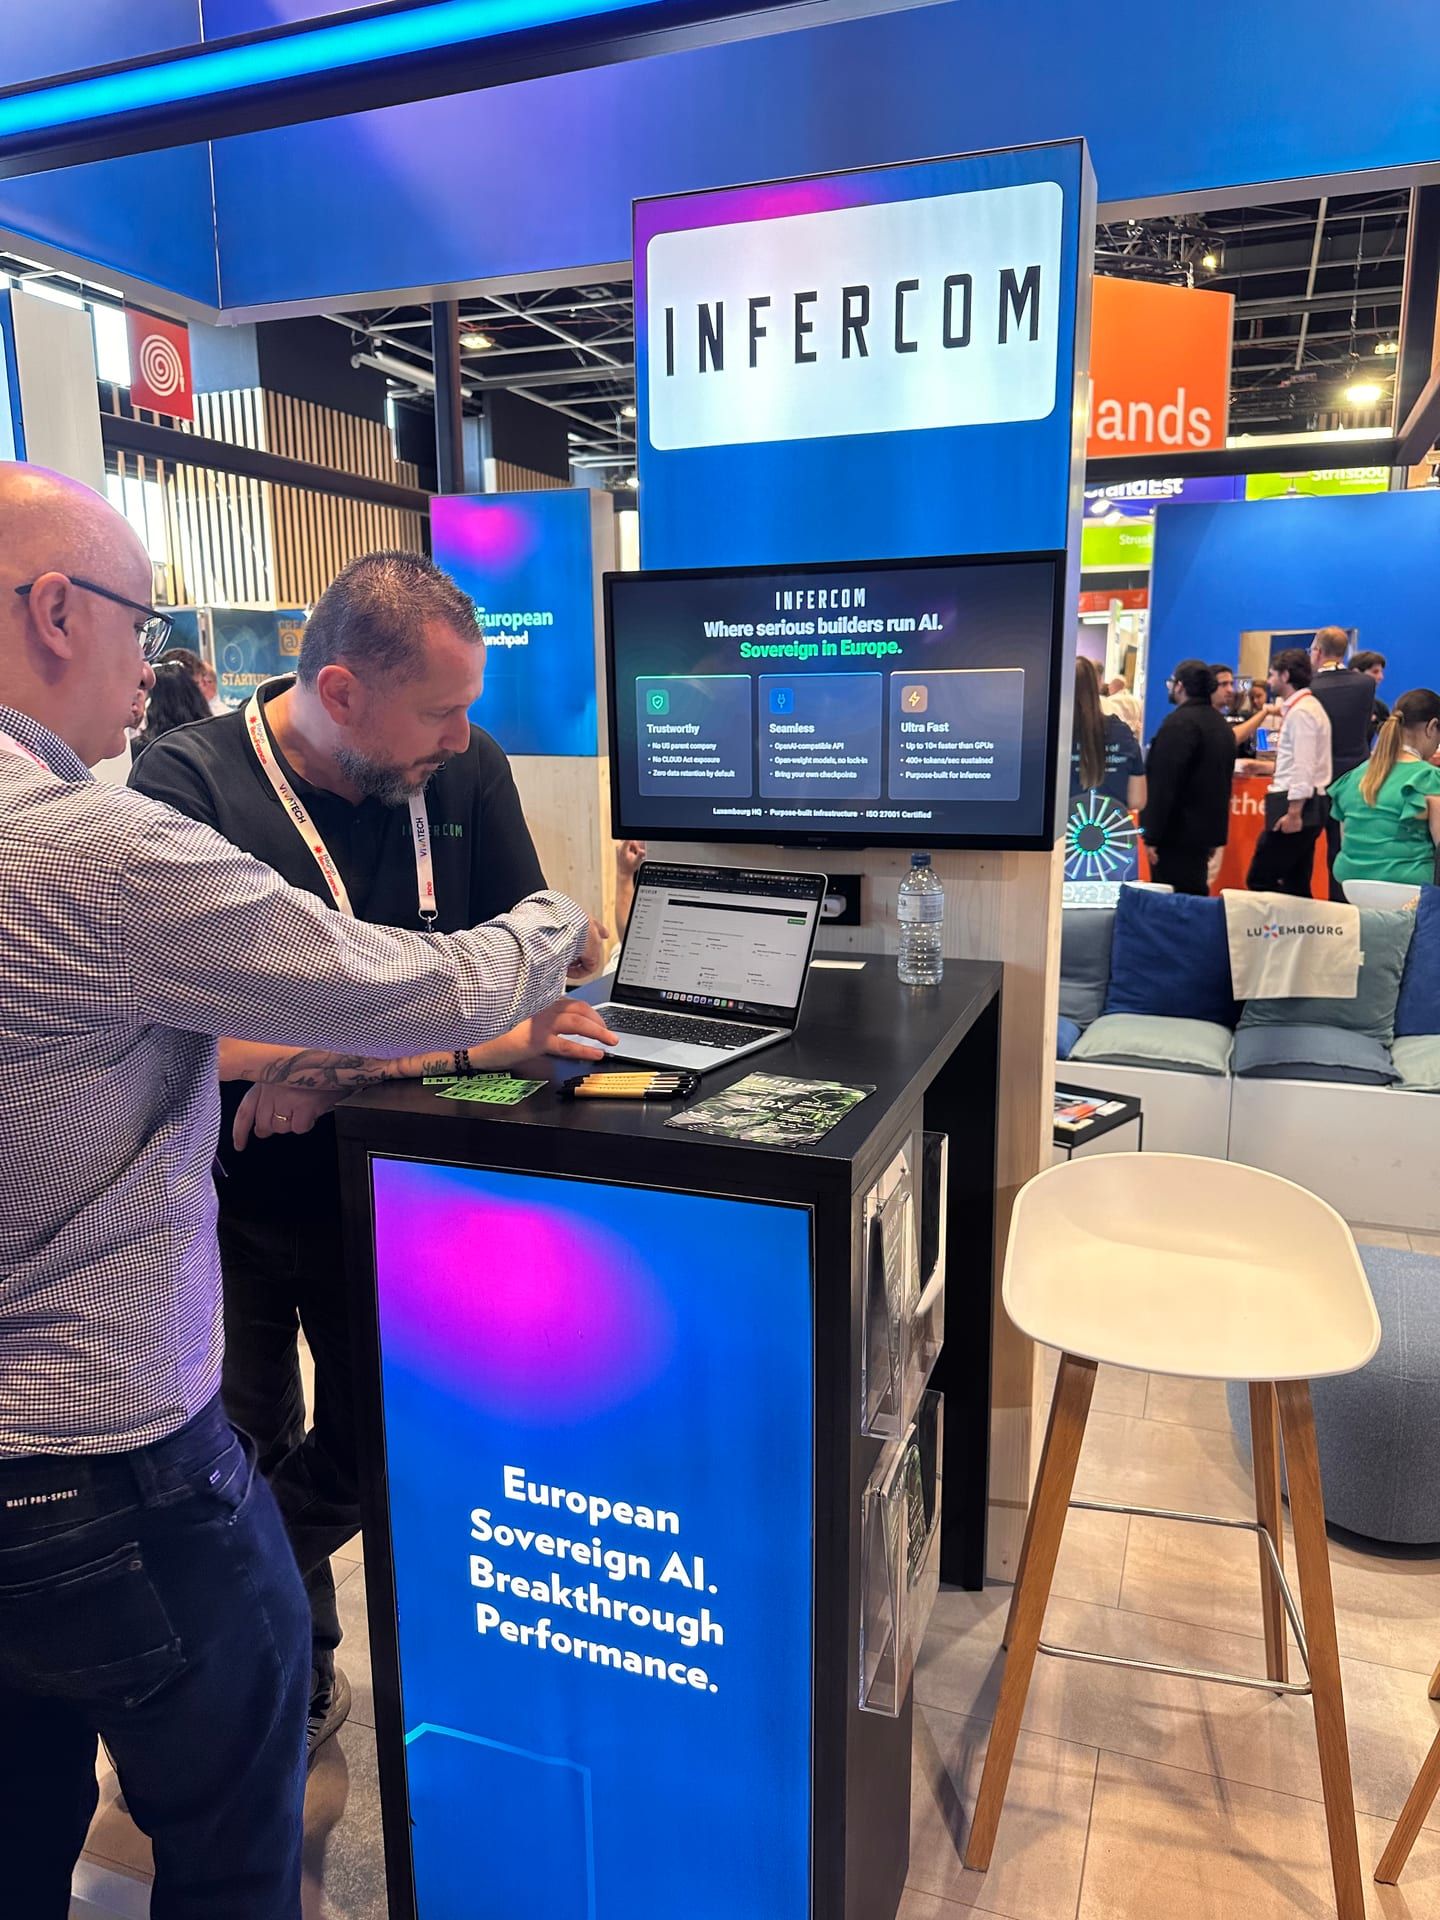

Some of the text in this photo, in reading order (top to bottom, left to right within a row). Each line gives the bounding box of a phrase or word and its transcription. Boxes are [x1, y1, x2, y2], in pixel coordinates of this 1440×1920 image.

[664, 265, 1041, 377] INFERCOM
[775, 587, 866, 610] INFERCOM
[703, 613, 943, 638] Where serious builders run AI.
[740, 638, 903, 661] Sovereign in Europe.
[646, 723, 700, 736] Trustworthy
[769, 723, 815, 735] Seamless
[900, 722, 950, 733] Ultra Fast
[652, 742, 717, 751] No US parent company
[832, 742, 845, 750] API
[905, 742, 916, 751] Up
[938, 741, 957, 749] faster
[958, 741, 974, 749] than
[974, 741, 994, 750] GPUs
[662, 756, 682, 764] CLOUD
[683, 756, 693, 764] Act
[693, 757, 721, 765] exposure
[774, 756, 812, 765] Open-weight
[923, 756, 960, 765] tokens/sec
[960, 756, 994, 764] sustained
[652, 769, 736, 778] Zero data retention by default
[774, 770, 791, 779] Bring
[791, 772, 805, 780] your
[820, 771, 857, 779] checkpoints
[905, 770, 948, 780] Purpose-built
[949, 771, 959, 779] for
[712, 807, 751, 817] Luxembourg
[751, 808, 763, 817] HQ
[769, 808, 812, 818] Purpose-built
[866, 810, 878, 819] ISO
[879, 810, 900, 819] 27001
[901, 811, 932, 819] Certified
[1247, 923, 1344, 939] LUXEMBOURG
[503, 1464, 680, 1535] European
[470, 1508, 719, 1594] Sovereign AI.
[469, 1554, 724, 1646] Breakthrough
[476, 1602, 719, 1693] Performance.
